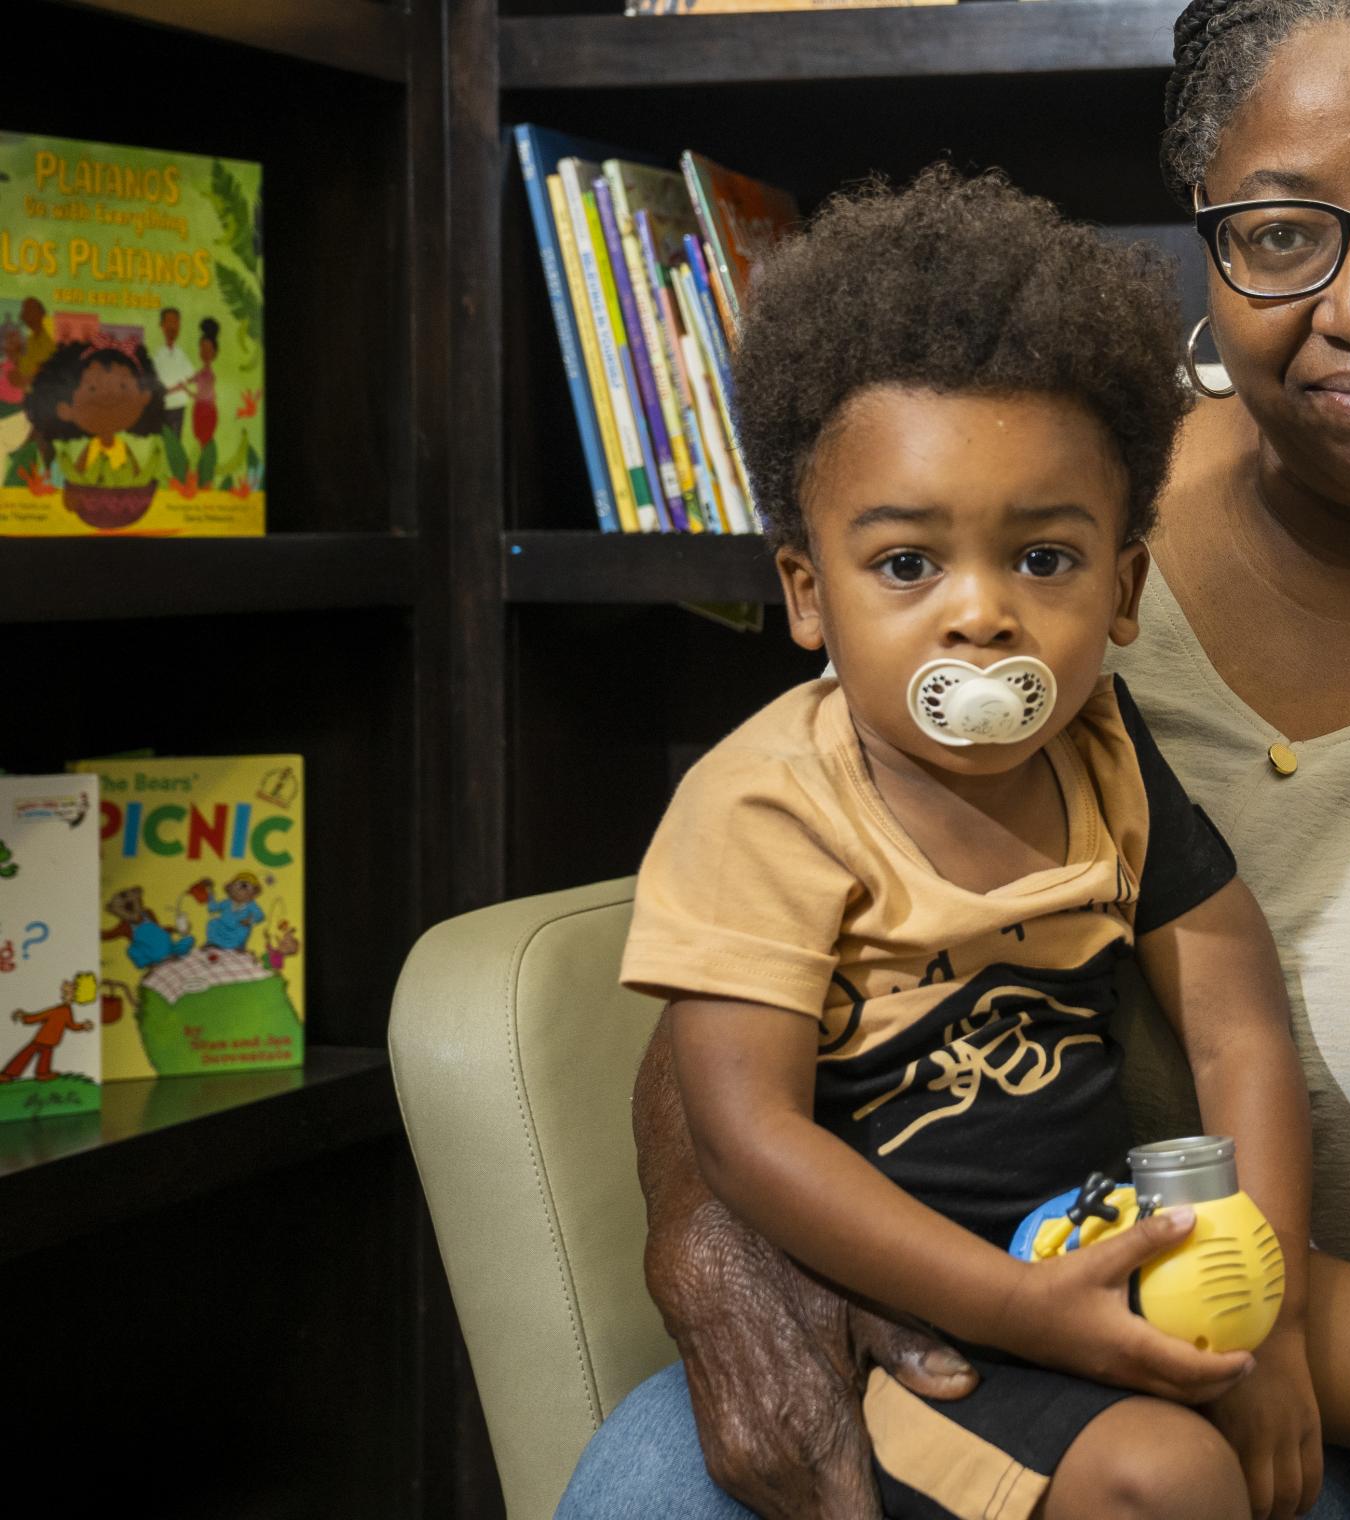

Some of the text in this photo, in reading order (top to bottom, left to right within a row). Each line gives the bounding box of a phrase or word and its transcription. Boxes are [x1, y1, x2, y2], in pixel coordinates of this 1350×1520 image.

[95, 203, 189, 241] Everything
[1, 228, 210, 289] LOS PLÁTANOS
[99, 800, 294, 868] PICNIC
